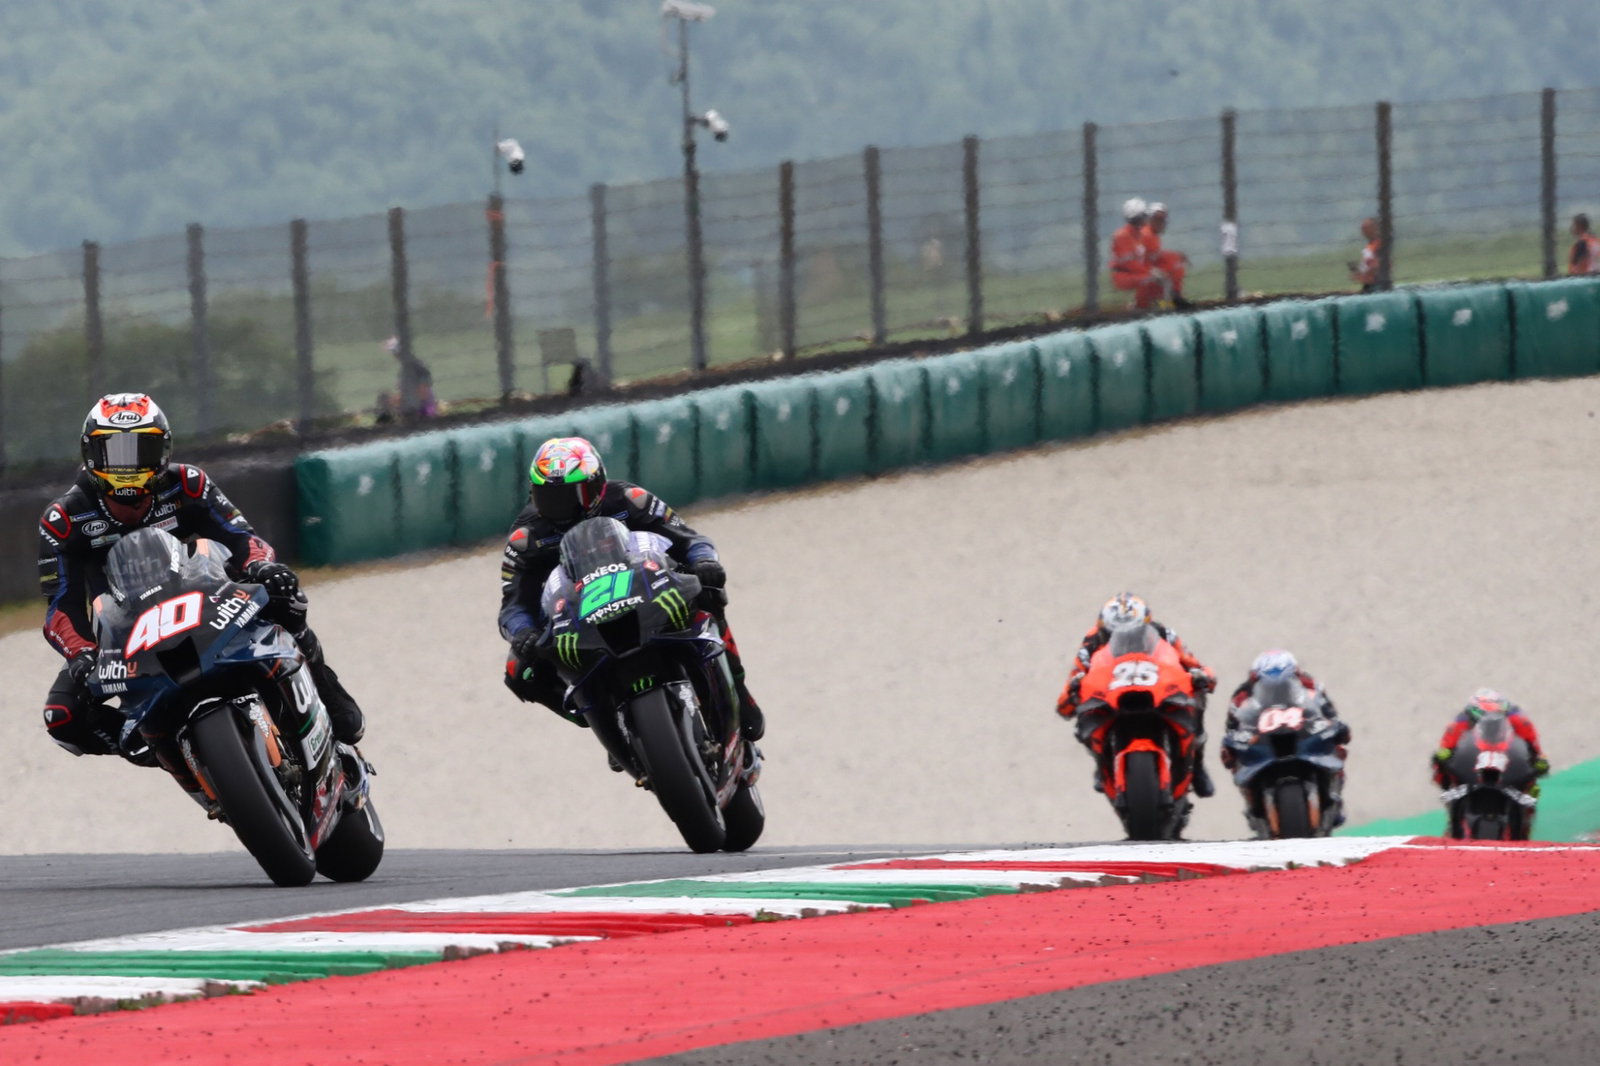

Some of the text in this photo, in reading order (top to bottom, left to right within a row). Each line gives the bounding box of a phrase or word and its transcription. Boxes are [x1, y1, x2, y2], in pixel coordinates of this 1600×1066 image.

[112, 411, 139, 422] Arai
[85, 520, 105, 532] Arai
[582, 563, 628, 585] ENEOS
[139, 585, 162, 600] YAMAHA
[579, 569, 634, 620] 21
[209, 589, 250, 630] withU
[234, 600, 260, 628] YAMAHA
[585, 596, 645, 623] MONSTER
[125, 591, 204, 659] 40
[98, 661, 137, 679] withU
[101, 682, 128, 694] YAMAHA
[1257, 707, 1304, 733] 04
